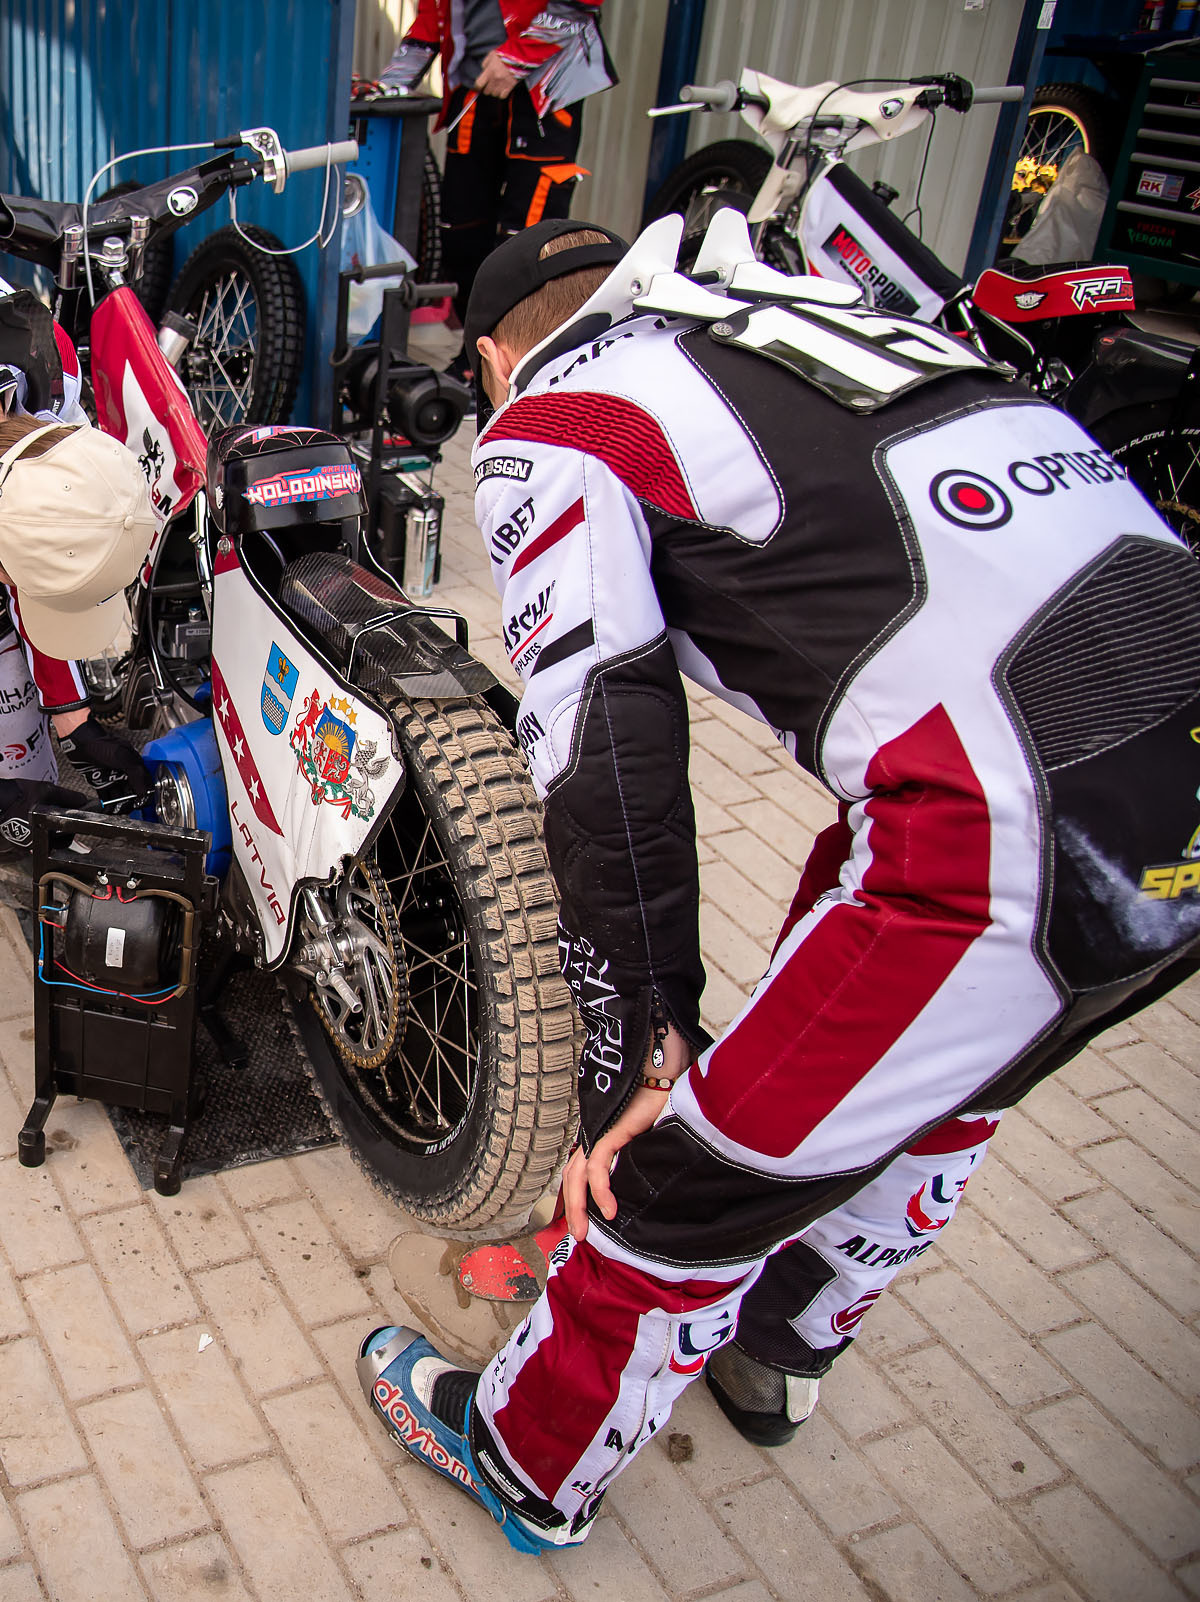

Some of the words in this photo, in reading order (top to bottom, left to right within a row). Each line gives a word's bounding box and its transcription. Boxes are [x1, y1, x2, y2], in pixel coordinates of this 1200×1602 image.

[1139, 180, 1161, 193] RK
[1008, 449, 1128, 497] OPTIBE
[230, 800, 286, 926] LATVIA
[373, 1377, 480, 1495] dayton
